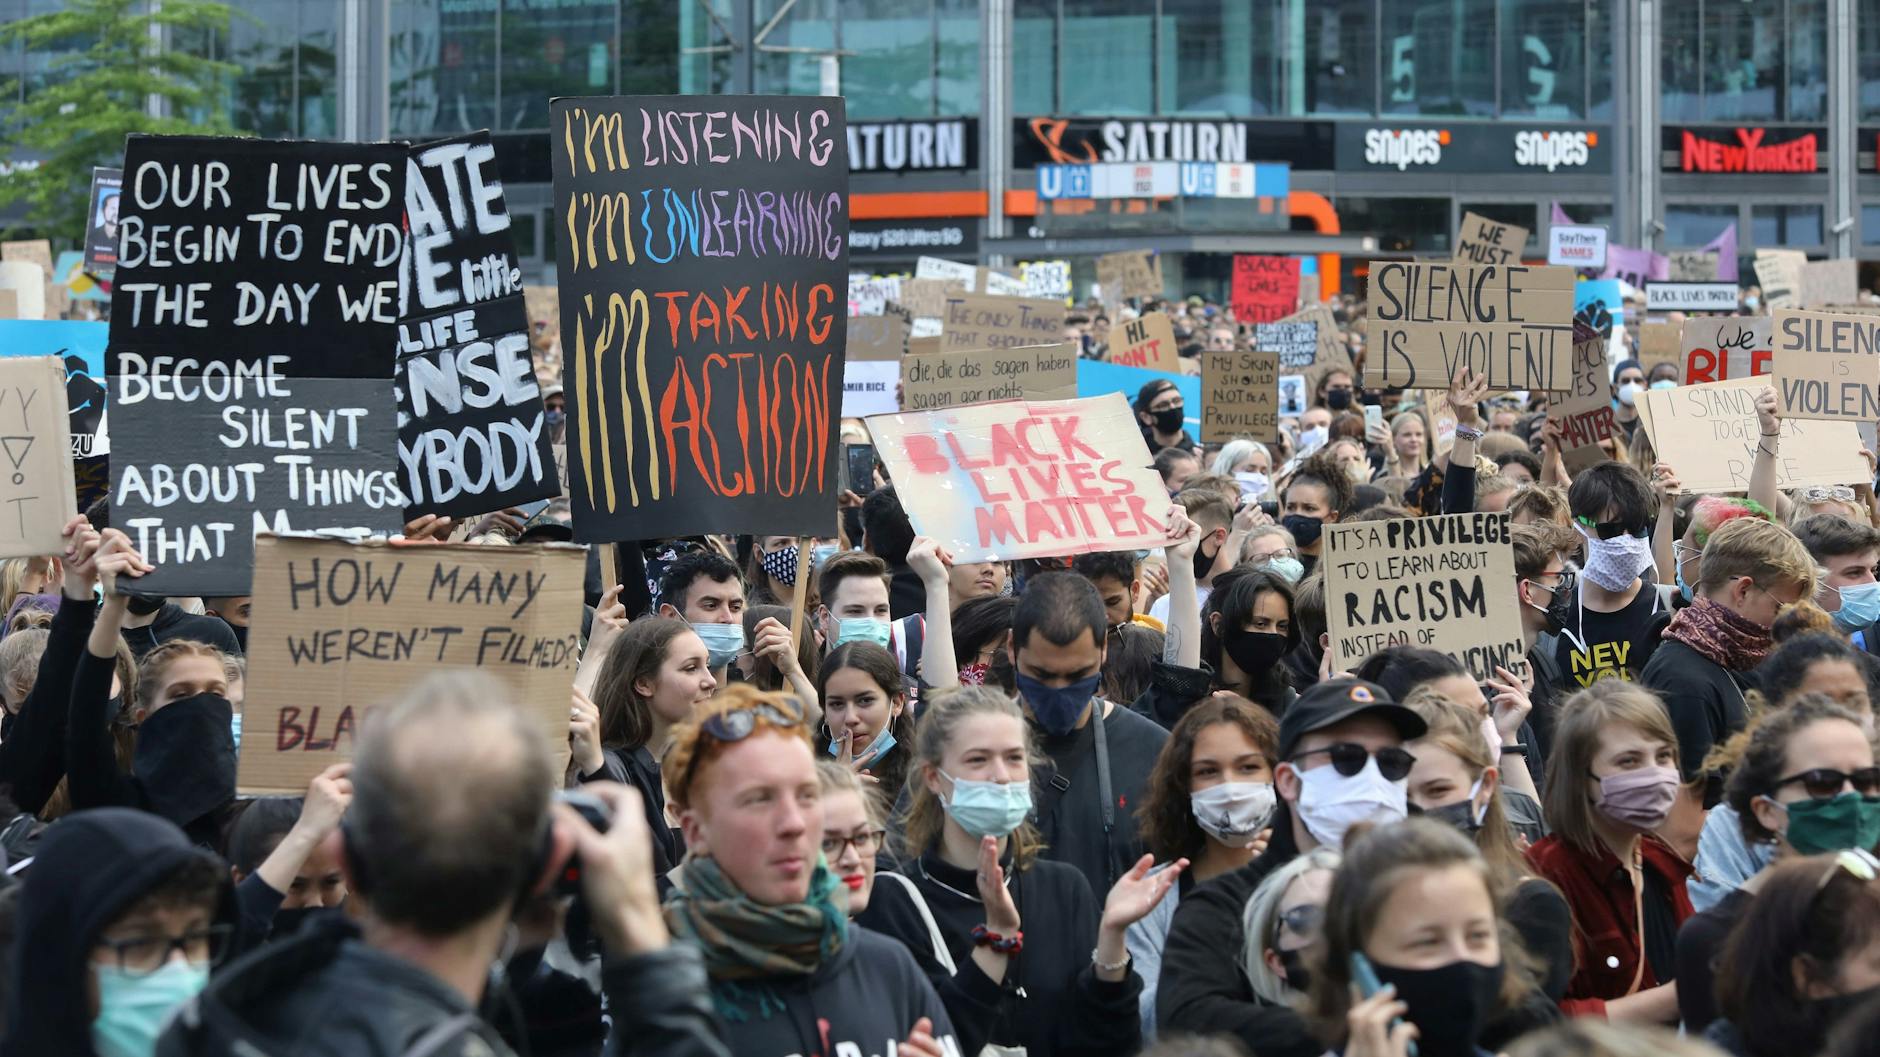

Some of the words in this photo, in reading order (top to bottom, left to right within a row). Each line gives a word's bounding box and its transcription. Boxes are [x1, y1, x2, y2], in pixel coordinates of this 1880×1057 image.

[640, 108, 834, 167] LISTENING
[1103, 119, 1247, 163] SATURN
[1365, 130, 1440, 171] snipes
[1515, 131, 1588, 172] snipes
[135, 161, 232, 211] OUR
[267, 163, 392, 211] LIVES
[1040, 167, 1062, 198] U
[1182, 163, 1198, 194] U
[117, 215, 241, 269] BEGIN
[247, 213, 302, 261] TO
[324, 220, 401, 267] END
[641, 188, 842, 264] UNLEARNING
[1478, 222, 1507, 245] WE
[1238, 255, 1292, 275] BLACK
[1458, 240, 1512, 264] MUST
[1560, 247, 1594, 258] NAMES
[399, 231, 459, 318] E
[461, 253, 524, 304] little
[1377, 263, 1529, 323] SILENCE
[120, 282, 209, 328] THE
[234, 282, 320, 326] DAY
[338, 281, 399, 325] WE
[654, 282, 834, 348] TAKING
[946, 299, 970, 325] THE
[976, 312, 1014, 329] ONLY
[1018, 304, 1060, 331] THING
[1650, 288, 1679, 303] BLACK
[1682, 288, 1705, 303] LIVES
[1707, 288, 1736, 303] MATTER
[400, 310, 480, 353] LIFE
[946, 330, 979, 346] THAT
[1716, 324, 1756, 350] We
[117, 352, 292, 404] BECOME
[397, 334, 540, 420] NSE
[909, 357, 935, 383] die,
[937, 360, 953, 379] die
[959, 357, 981, 378] das
[992, 358, 1029, 379] sagen
[1036, 353, 1070, 371] haben
[1240, 353, 1275, 371] SKIN
[1382, 329, 1416, 390] IS
[1439, 325, 1573, 391] VIOLENT
[1832, 360, 1850, 376] IS
[866, 382, 886, 392] RICE
[912, 390, 952, 410] sagen
[988, 382, 1024, 401] nichts
[1213, 389, 1244, 402] NOT
[1258, 391, 1270, 404] A
[1221, 375, 1274, 386] SHOULD
[1205, 406, 1277, 426] PRIVILEGE
[1666, 391, 1677, 417] I
[1688, 388, 1757, 418] STAND
[218, 405, 369, 452] SILENT
[659, 352, 832, 498] ACTION
[904, 415, 1104, 475] BLACK
[1558, 405, 1621, 449] MATTER
[1710, 418, 1804, 440] TOGEER
[116, 463, 266, 507] ABOUT
[273, 455, 408, 509] THINGS
[970, 460, 1136, 503] LIVES
[1727, 458, 1803, 488] RE
[125, 518, 235, 565] THAT
[975, 495, 1168, 548] MATTER
[1387, 513, 1511, 551] PRIVILEGE
[1337, 561, 1369, 581] TO
[1377, 554, 1434, 581] LEARN
[1439, 551, 1488, 570] ABOUT
[288, 557, 404, 610] HOW
[428, 561, 547, 620] MANY
[1345, 574, 1487, 628] RACISM
[288, 626, 463, 667] WEREN'T
[476, 626, 577, 670] FILMED?
[1341, 629, 1409, 659] INSTEAD
[1417, 628, 1436, 645] OF
